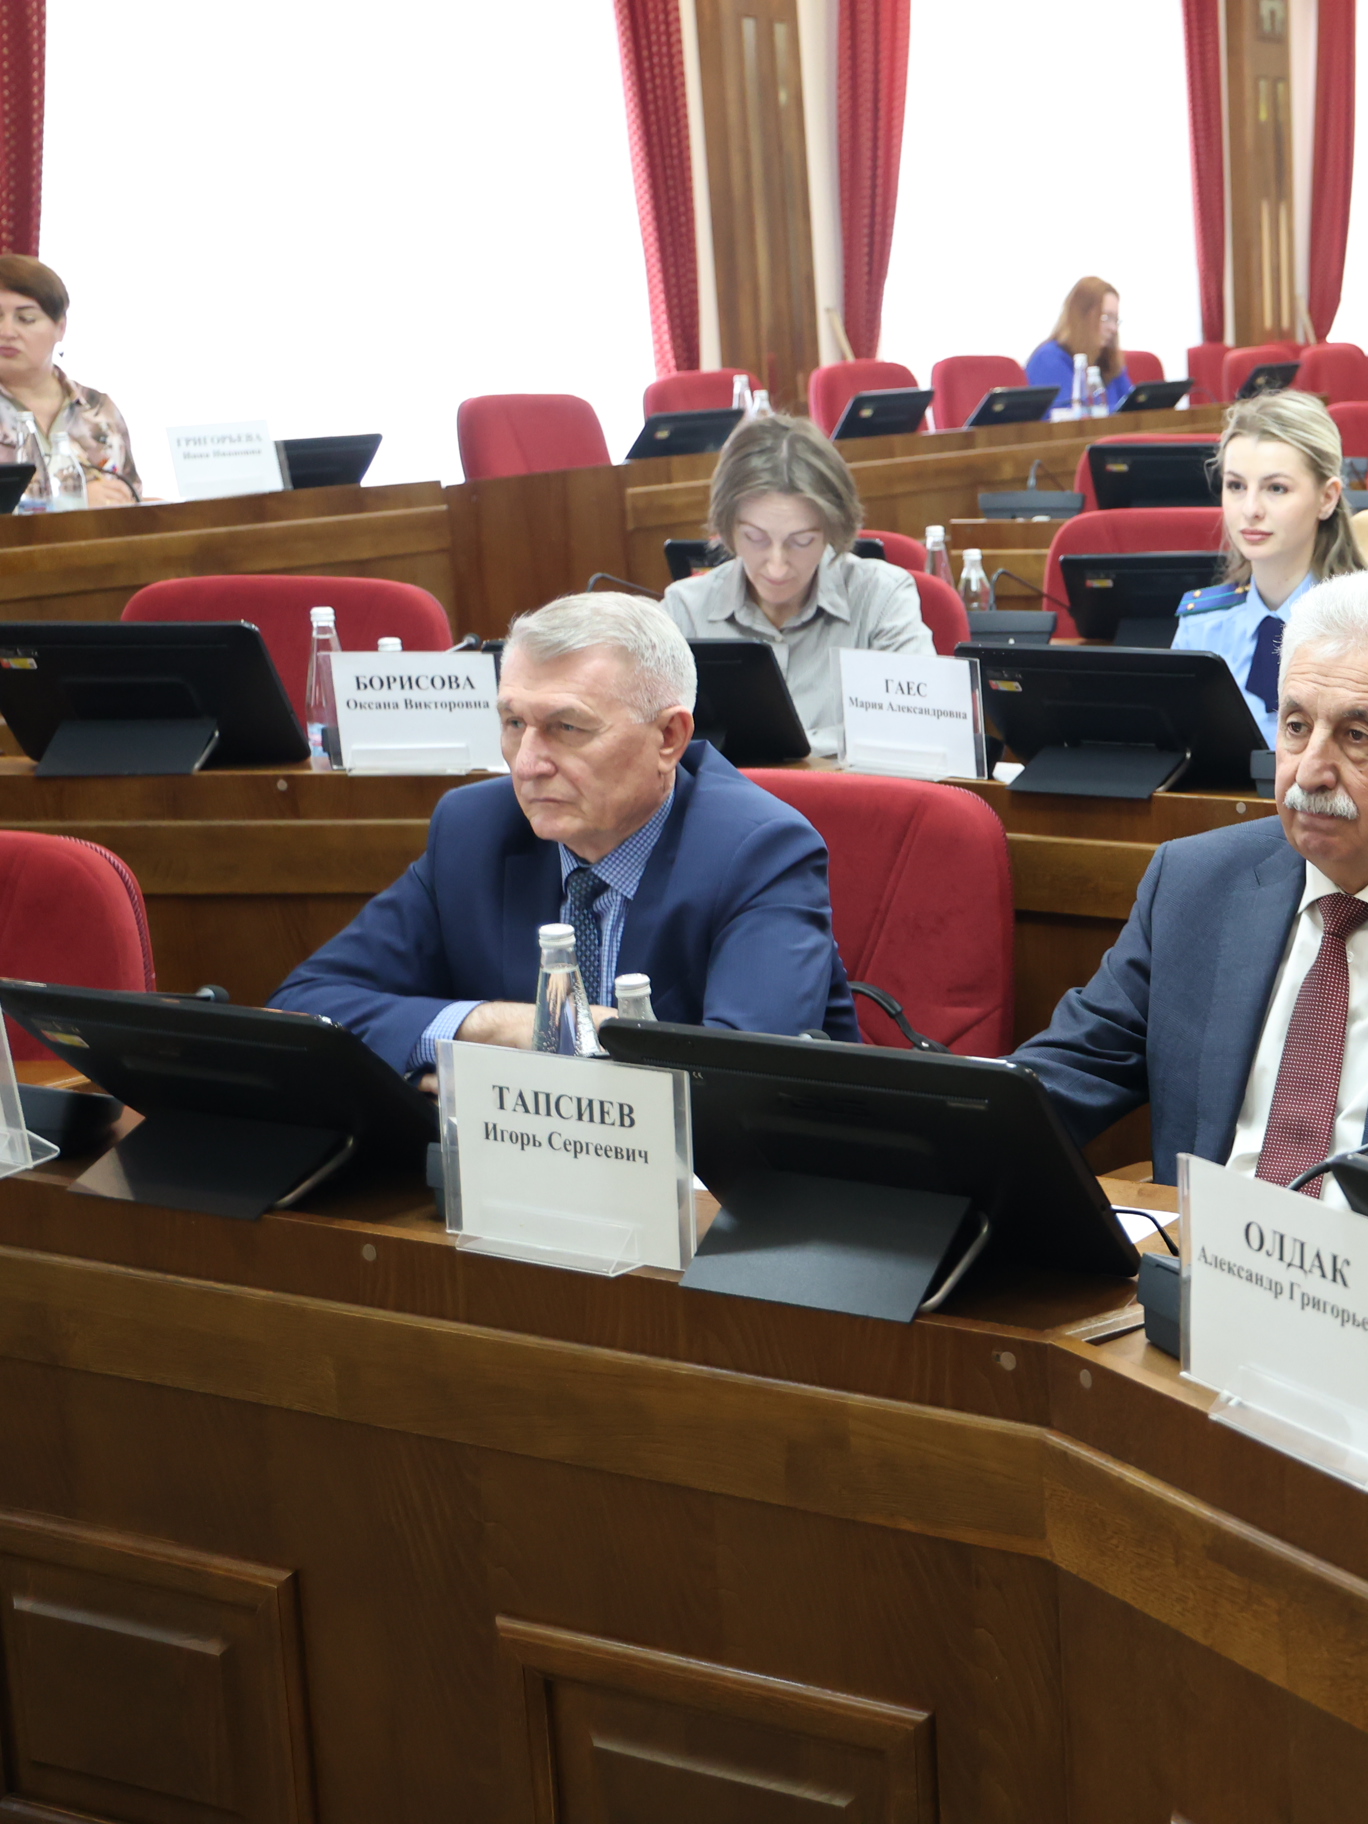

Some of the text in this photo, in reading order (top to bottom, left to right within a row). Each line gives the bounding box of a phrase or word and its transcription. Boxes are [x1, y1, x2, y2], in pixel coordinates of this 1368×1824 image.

[354, 674, 476, 692] БОРИСОВА
[884, 678, 928, 698] ГАЕС
[346, 698, 490, 713] Оксана Викторовна
[848, 696, 968, 720] Мария Александровна
[491, 1084, 637, 1129] ТАПСИЕВ
[483, 1121, 650, 1165] Игорь Сергеевич
[1243, 1220, 1353, 1290] ОЛДАК
[1196, 1245, 1285, 1300] Александр
